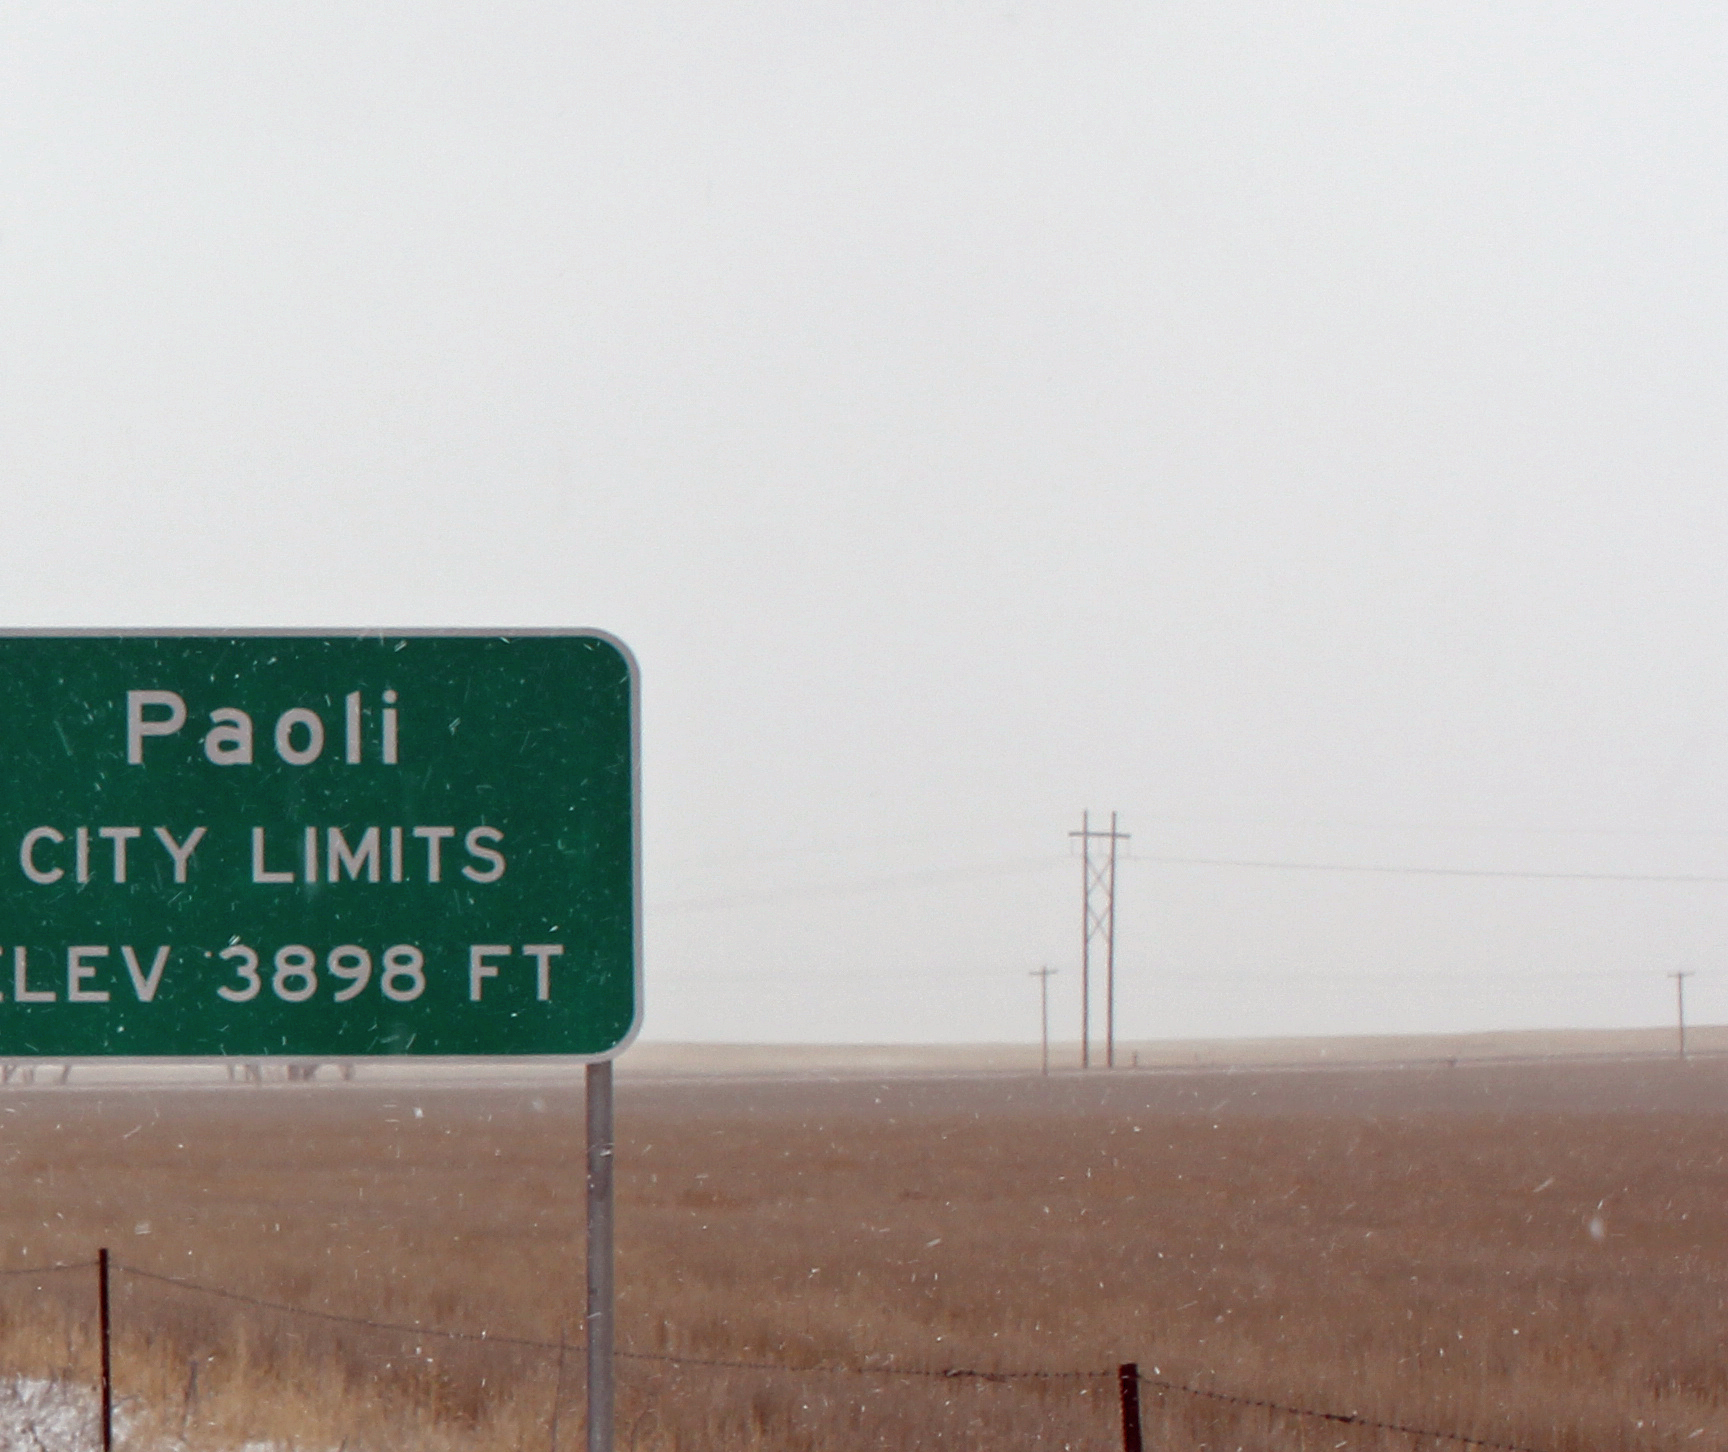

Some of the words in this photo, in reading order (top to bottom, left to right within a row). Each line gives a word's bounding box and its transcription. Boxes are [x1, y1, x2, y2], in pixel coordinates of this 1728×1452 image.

[125, 689, 399, 766] Paoli
[19, 825, 208, 885] CITY
[251, 825, 507, 885] LIMITS
[215, 944, 427, 1002] 3898
[468, 943, 565, 1002] FT
